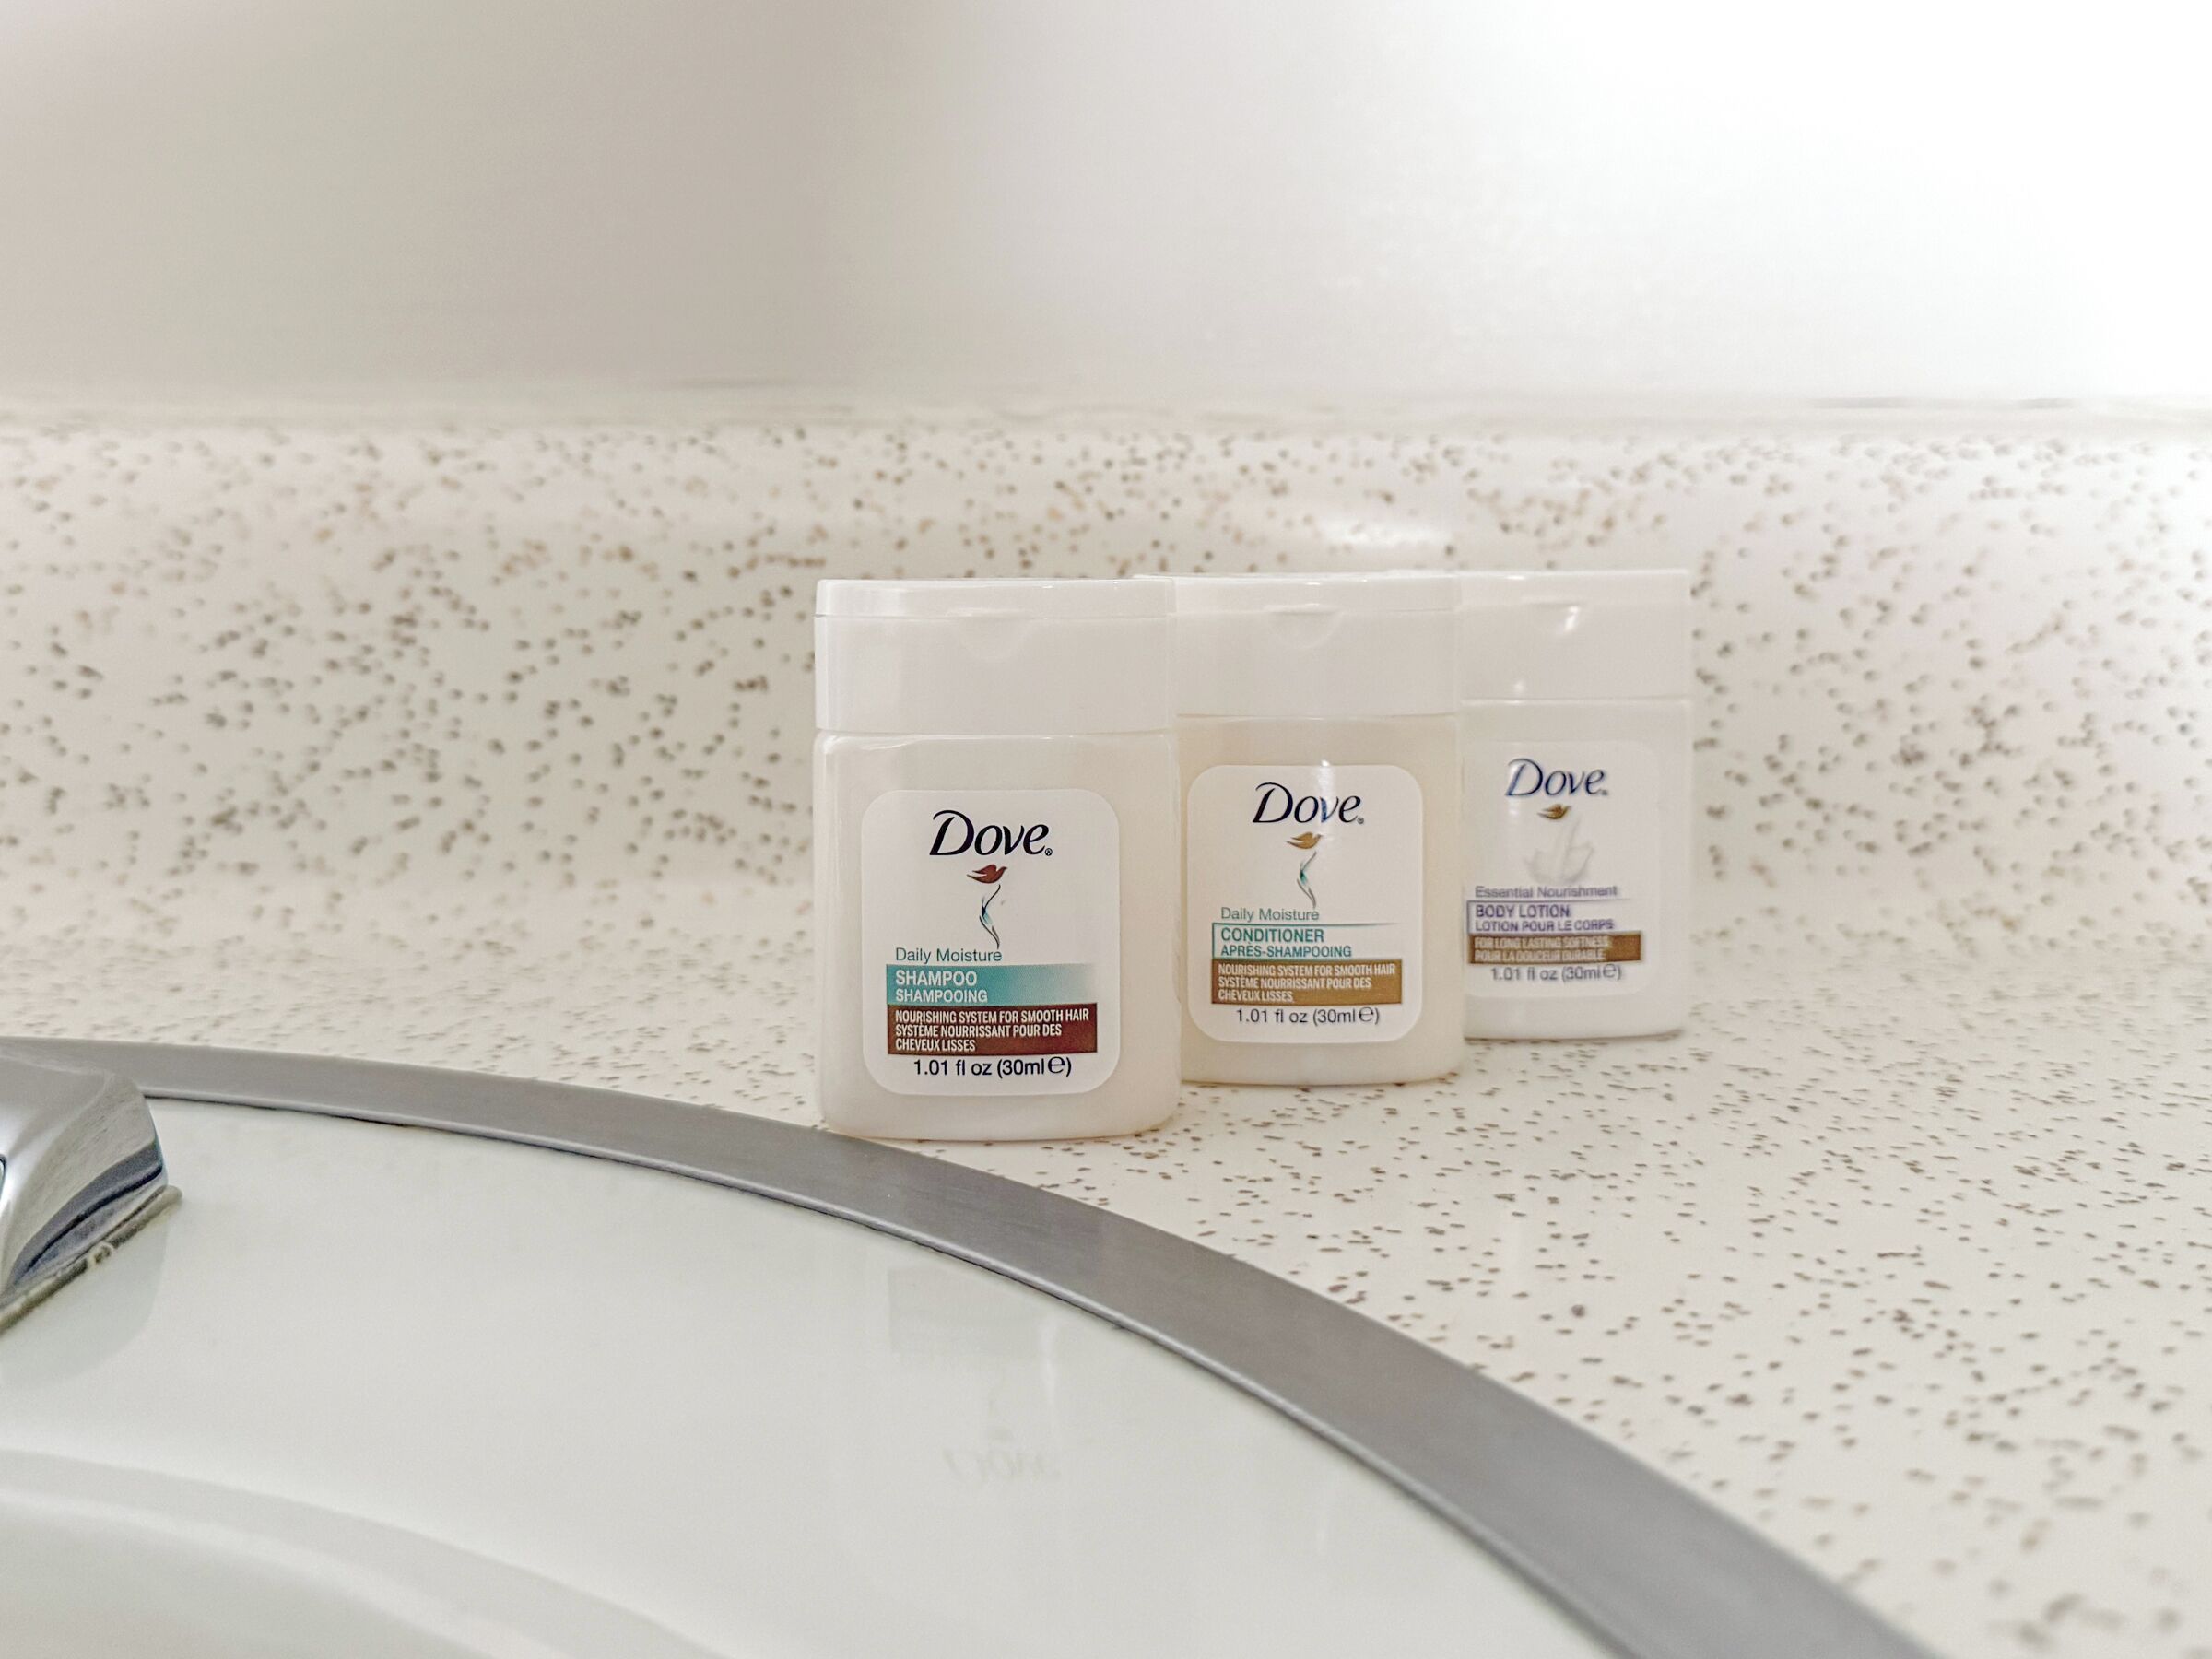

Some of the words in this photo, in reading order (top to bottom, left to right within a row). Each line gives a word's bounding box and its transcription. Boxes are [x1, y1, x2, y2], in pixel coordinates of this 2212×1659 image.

[1505, 758, 1605, 796] Dove
[1253, 782, 1361, 823] Dove
[929, 810, 1050, 856] Dove
[1475, 886, 1534, 898] Essential
[1536, 885, 1618, 898] Nourishment
[1221, 907, 1253, 922] Daily
[1259, 908, 1319, 921] Moisture
[1476, 904, 1514, 918] BODY
[1519, 904, 1571, 918] LOTION
[1476, 921, 1518, 932] LOTION
[1522, 921, 1554, 931] POUR
[1558, 920, 1571, 931] LE
[1574, 919, 1615, 930] CORPS
[1221, 927, 1324, 943] CONDITIONER
[896, 947, 931, 964] Daily
[937, 947, 1002, 962] Moisture
[1220, 942, 1352, 958] APRÈS-SHAMPOOING
[1218, 963, 1276, 976] NOURISHING
[1277, 964, 1312, 977] SYSTEM
[1314, 965, 1332, 976] FOR
[1334, 964, 1372, 976] SMOOTH
[1374, 963, 1395, 975] HAIR
[1492, 967, 1521, 981] 1.01
[1540, 970, 1558, 981] oz
[895, 970, 977, 986] SHAMPOO
[1218, 975, 1258, 988] SYSTÈME
[1261, 977, 1325, 989] NOURRISSANT
[1326, 977, 1352, 989] POUR
[1354, 977, 1371, 988] DES
[895, 989, 988, 1004] SHAMPOOING
[1218, 990, 1260, 1001] CHEVEUX
[896, 1010, 957, 1023] NOURISHING
[959, 1010, 997, 1024] SYSTEM
[1000, 1011, 1018, 1023] FOR
[1021, 1010, 1064, 1022] SMOOTH
[1065, 1008, 1089, 1021] HAIR
[1236, 1008, 1267, 1023] 1.01
[1275, 1008, 1284, 1023] fl
[1290, 1012, 1308, 1023] oz
[896, 1022, 938, 1037] SYSTÈME
[940, 1025, 1010, 1038] NOURRISSANT
[1014, 1024, 1040, 1037] POUR
[1042, 1023, 1062, 1036] DES
[896, 1039, 940, 1052] CHEVEUX
[942, 1039, 975, 1052] LISSES
[914, 1060, 947, 1075] 1.01
[956, 1060, 966, 1075] fl
[971, 1063, 992, 1076] oz
